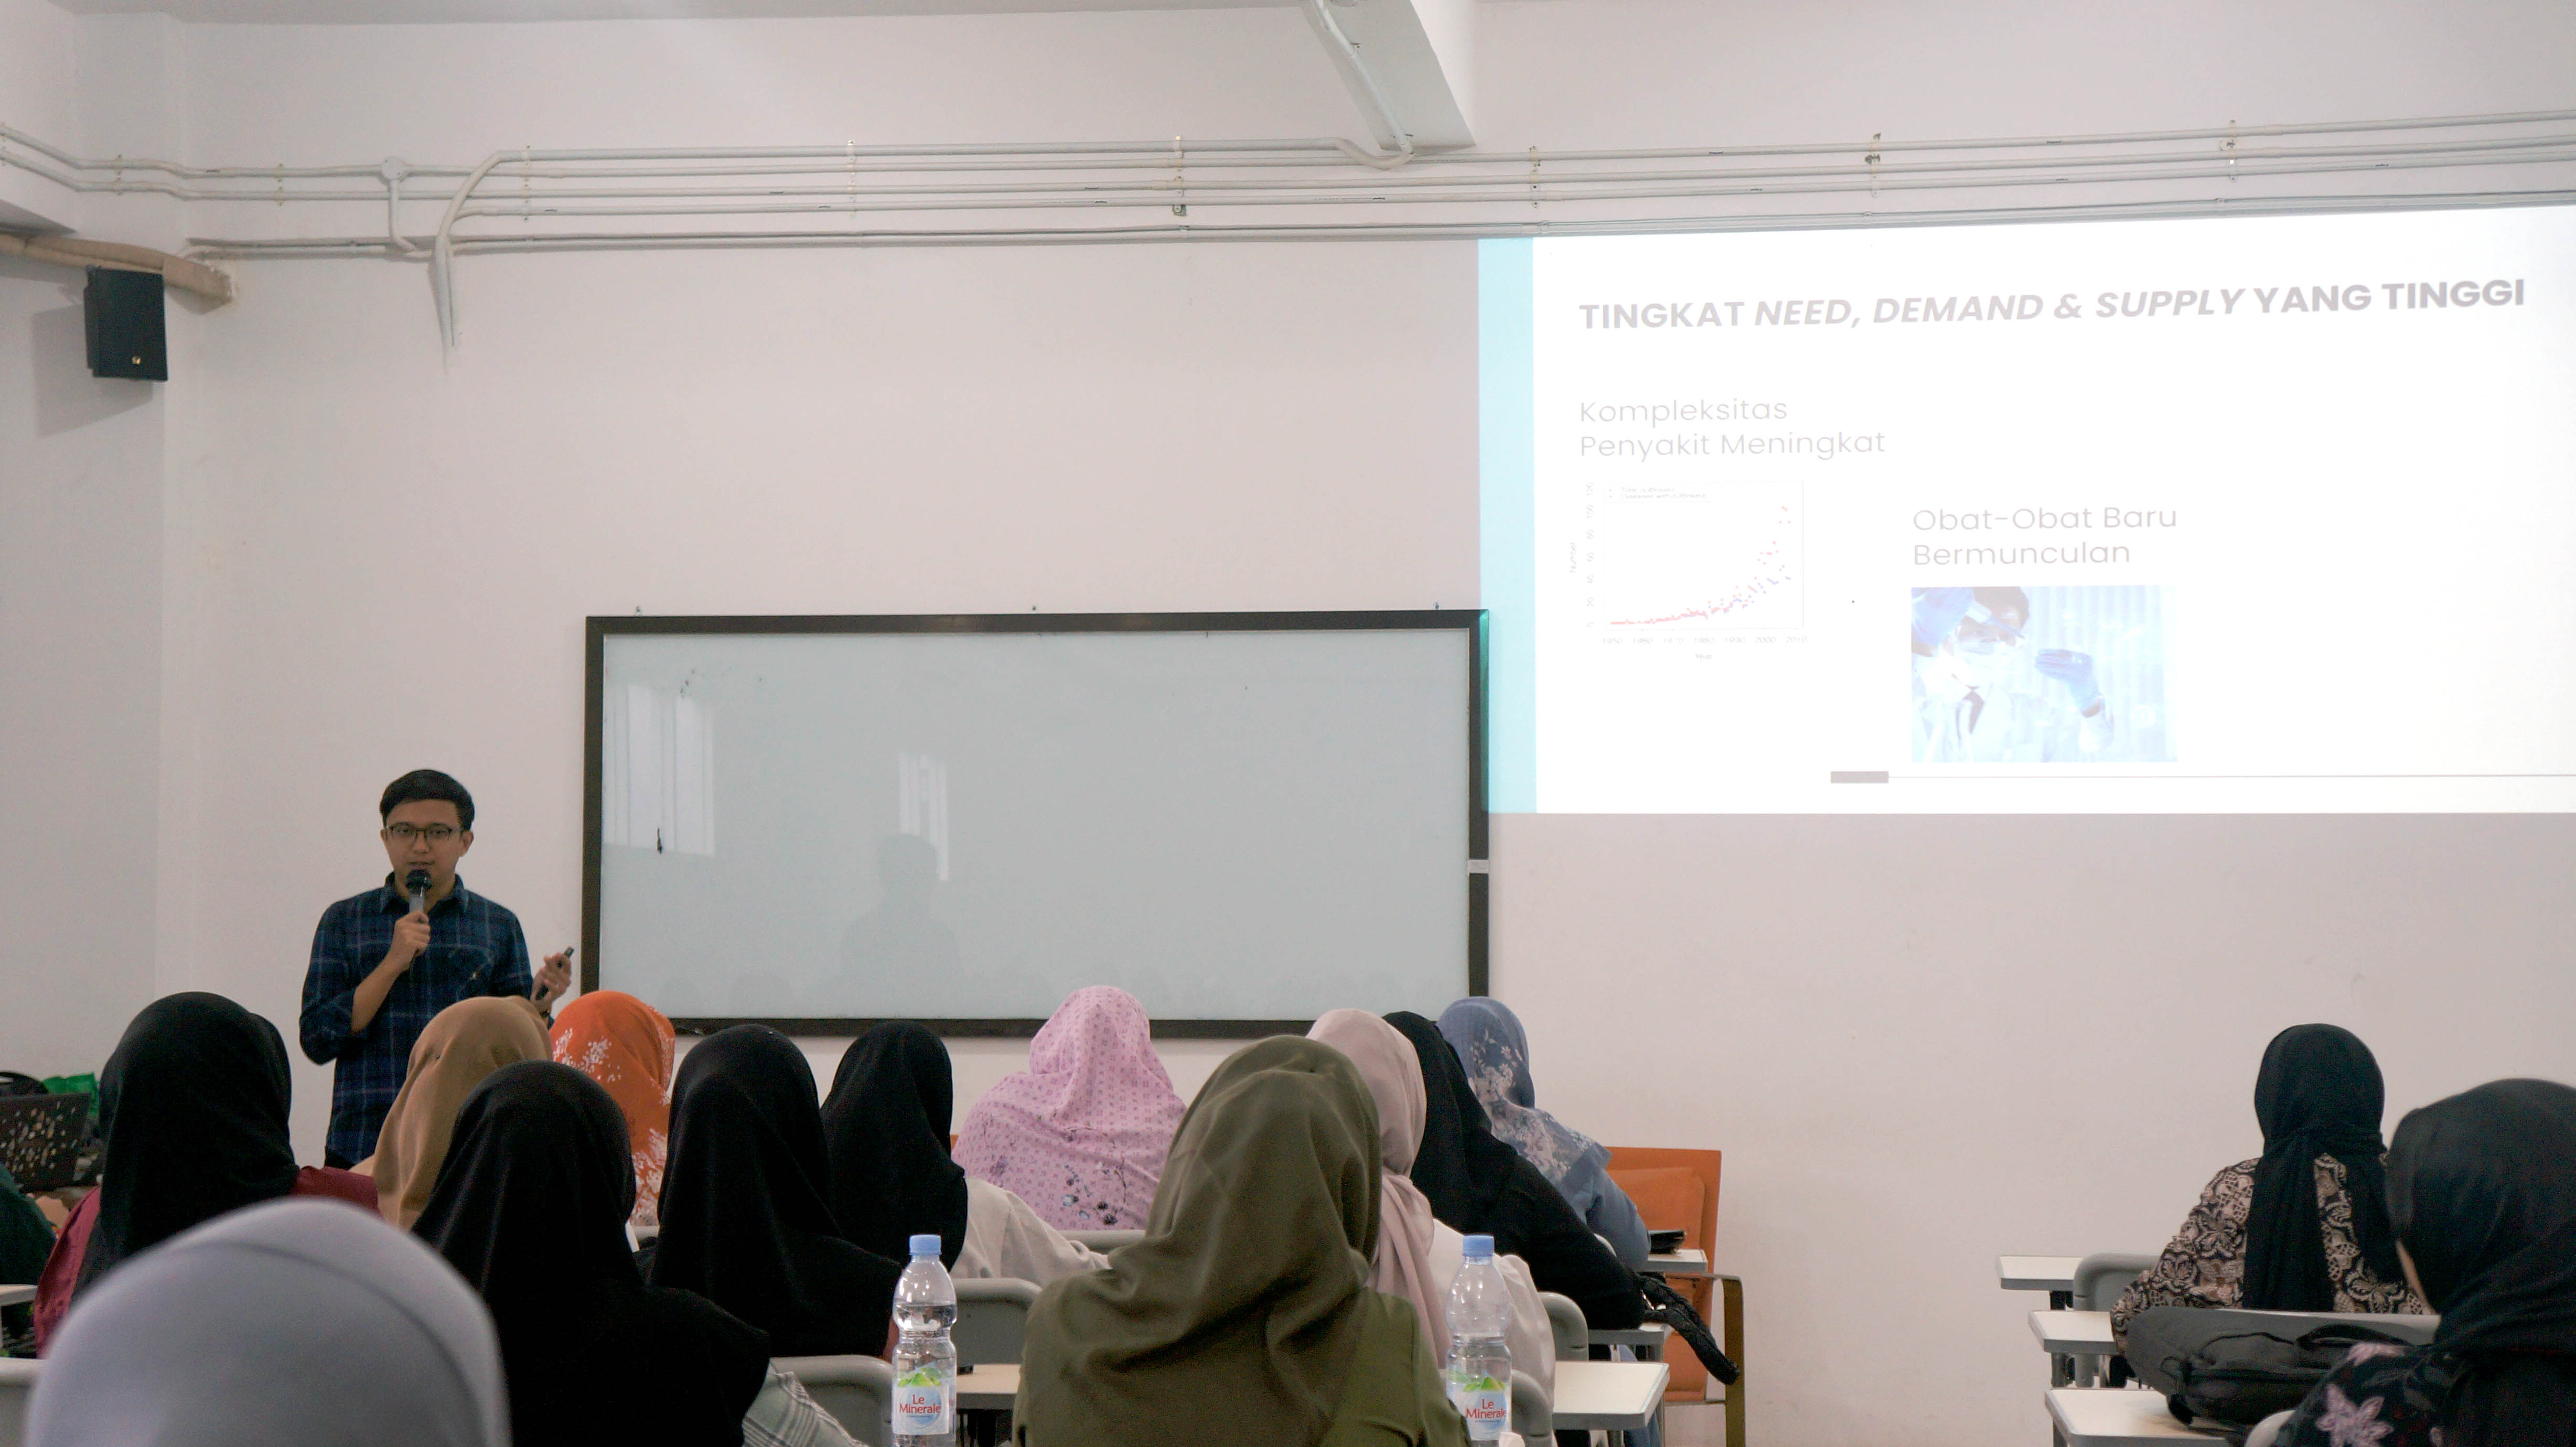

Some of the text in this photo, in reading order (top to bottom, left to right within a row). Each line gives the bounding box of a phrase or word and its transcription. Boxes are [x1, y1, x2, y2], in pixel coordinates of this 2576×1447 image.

[1578, 277, 2526, 330] TINGKAT NEED, DEMAND & SUPPLY YANG TINGGI
[1580, 397, 1788, 429] Kompleksitas
[1581, 431, 1886, 463] Penyakit Meningkat
[1912, 506, 2177, 531] Obat-Obat Baru
[1913, 541, 2130, 566] Bermunculan
[899, 1403, 941, 1413] Minerale
[913, 1394, 925, 1405] Le
[1482, 1399, 1494, 1409] Le
[1466, 1408, 1507, 1419] Minerale
